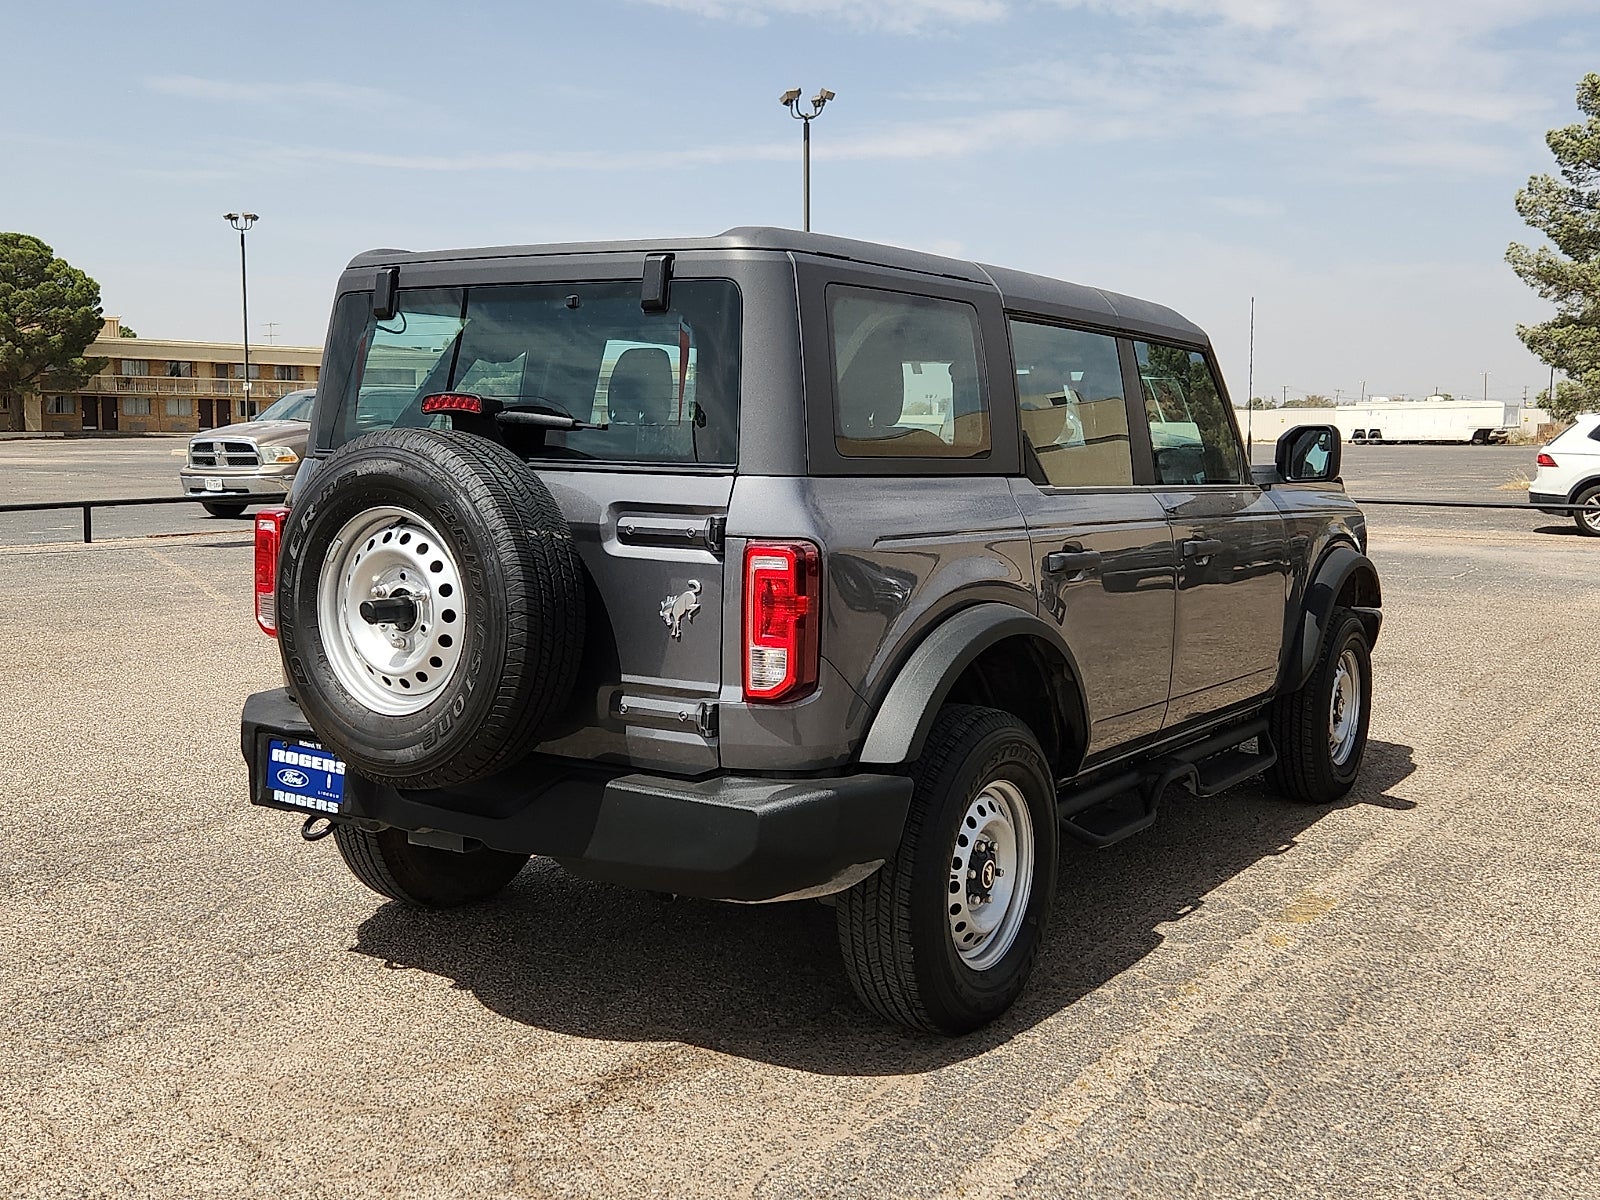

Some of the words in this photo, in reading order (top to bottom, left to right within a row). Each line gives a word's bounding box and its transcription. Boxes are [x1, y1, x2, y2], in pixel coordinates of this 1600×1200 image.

[422, 499, 489, 751] BRIDGESTONE
[272, 749, 346, 775] ROGERS
[282, 770, 304, 785] Ford
[273, 789, 339, 814] ROGERS
